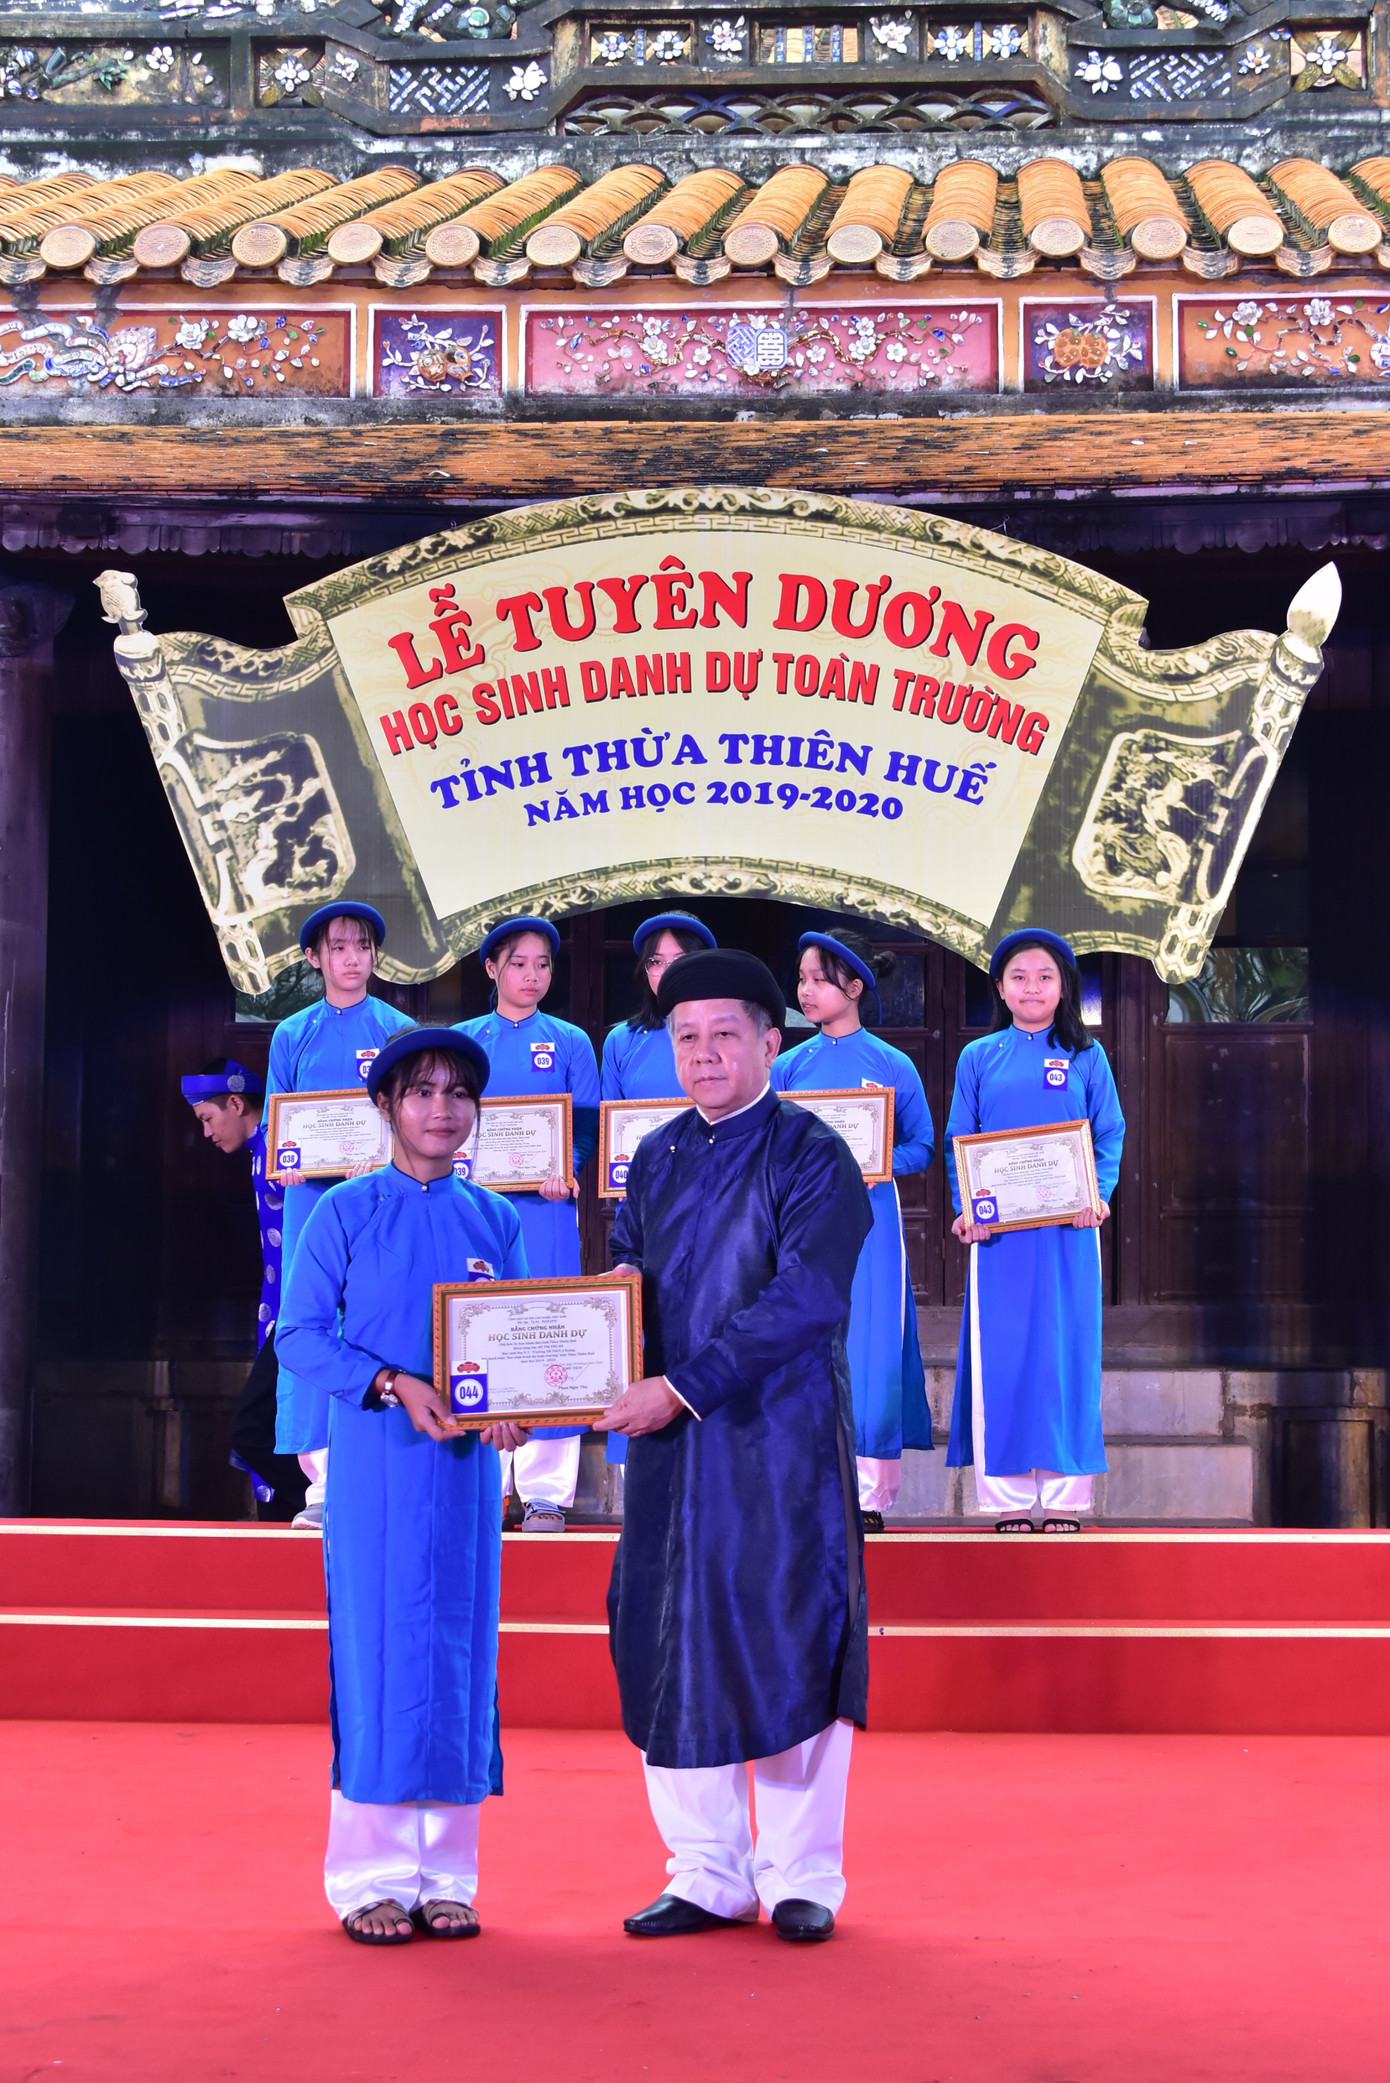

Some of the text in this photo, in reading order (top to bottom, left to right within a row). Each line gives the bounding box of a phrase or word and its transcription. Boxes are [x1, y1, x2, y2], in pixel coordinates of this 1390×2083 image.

[387, 555, 1040, 690] LỄ TUYÊN DƯƠNG
[379, 648, 1050, 756] HỌC SINH DANH DỰ TOÀN TRƯỜNG
[430, 726, 997, 809] TỈNH THỪA THIÊN HUẾ
[523, 780, 904, 827] NĂM HỌC 2019-2020
[537, 1057, 550, 1065] 039
[1049, 1073, 1063, 1082] 043
[282, 1154, 295, 1163] 038
[978, 1204, 993, 1215] 043
[488, 1333, 510, 1343] HỌC
[511, 1332, 536, 1340] SINH
[539, 1330, 568, 1339] DANH
[570, 1329, 587, 1338] DỰ
[459, 1385, 479, 1400] 044
